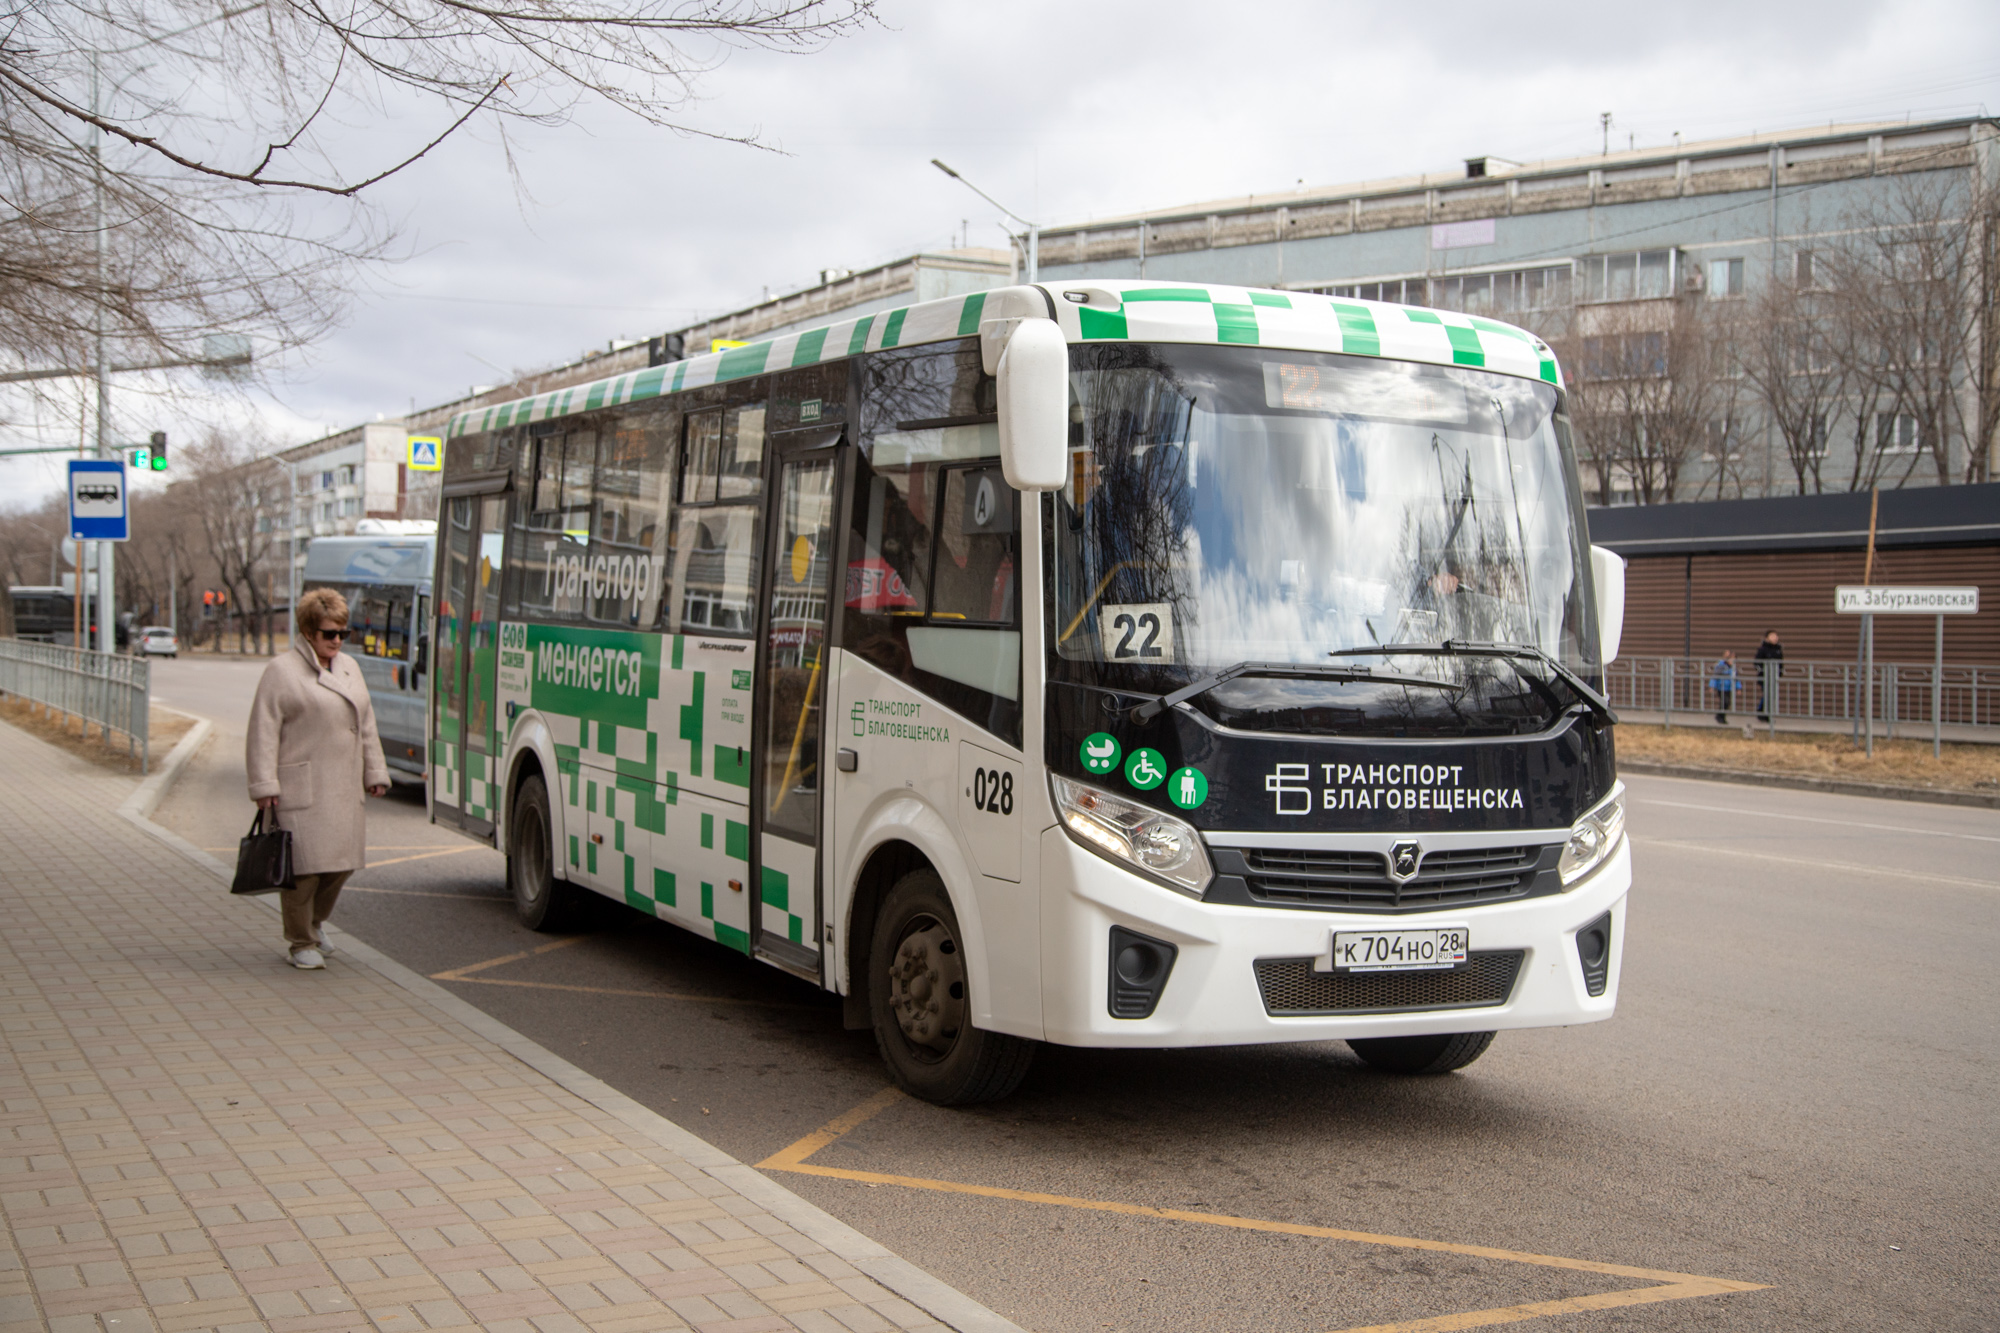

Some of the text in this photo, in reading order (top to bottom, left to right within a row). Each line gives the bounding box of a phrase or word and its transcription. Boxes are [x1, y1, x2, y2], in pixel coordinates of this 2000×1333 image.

[1280, 364, 1321, 407] 22
[802, 403, 819, 417] ВХОД
[544, 541, 664, 617] Транспорт
[1841, 588, 1976, 609] ул. Забурхановская
[1113, 612, 1163, 659] 22
[538, 641, 642, 697] меняется
[869, 699, 921, 718] ТРАНСПОРТ
[868, 720, 950, 742] БЛАГОВЕЩЕНСКА
[1321, 764, 1462, 785] ТРАНСПОРТ
[974, 766, 1014, 816] 028
[1323, 788, 1524, 812] БЛАГОВЕЩЕНСКА
[1440, 932, 1459, 951] 28
[1438, 951, 1453, 960] RUS
